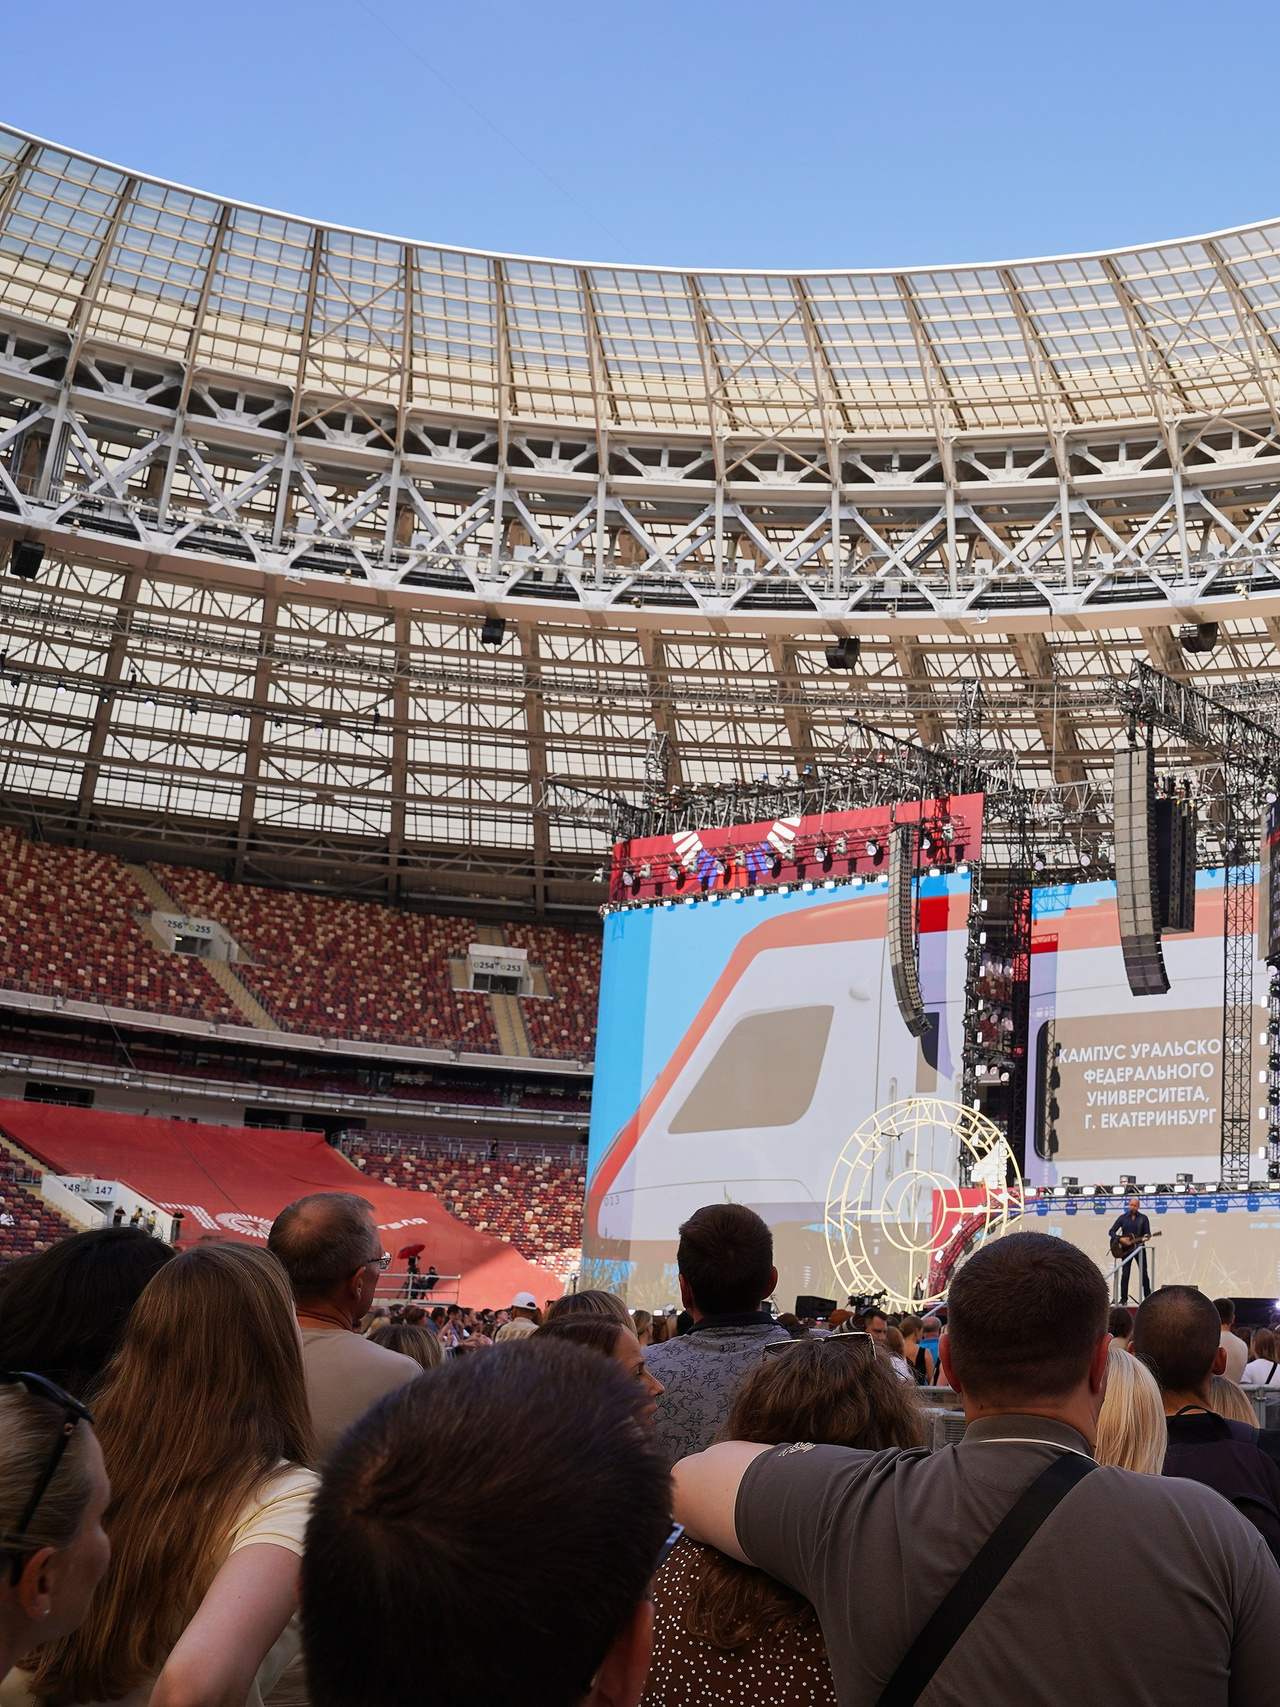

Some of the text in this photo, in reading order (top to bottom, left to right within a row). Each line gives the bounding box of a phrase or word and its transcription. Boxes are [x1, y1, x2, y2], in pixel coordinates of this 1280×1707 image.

[167, 920, 183, 929] 256
[195, 925, 211, 934] 255
[480, 961, 495, 969] 254
[507, 964, 521, 972] 253
[1058, 1044, 1127, 1064] КАМПУС
[1083, 1062, 1215, 1085] ФЕДЕРАЛЬНОГО
[1086, 1086, 1210, 1107] УНИВЕРСИТЕТА,
[1084, 1108, 1217, 1129] Г. ЕКАТЕРИНБУРГ
[95, 1186, 112, 1195] 147
